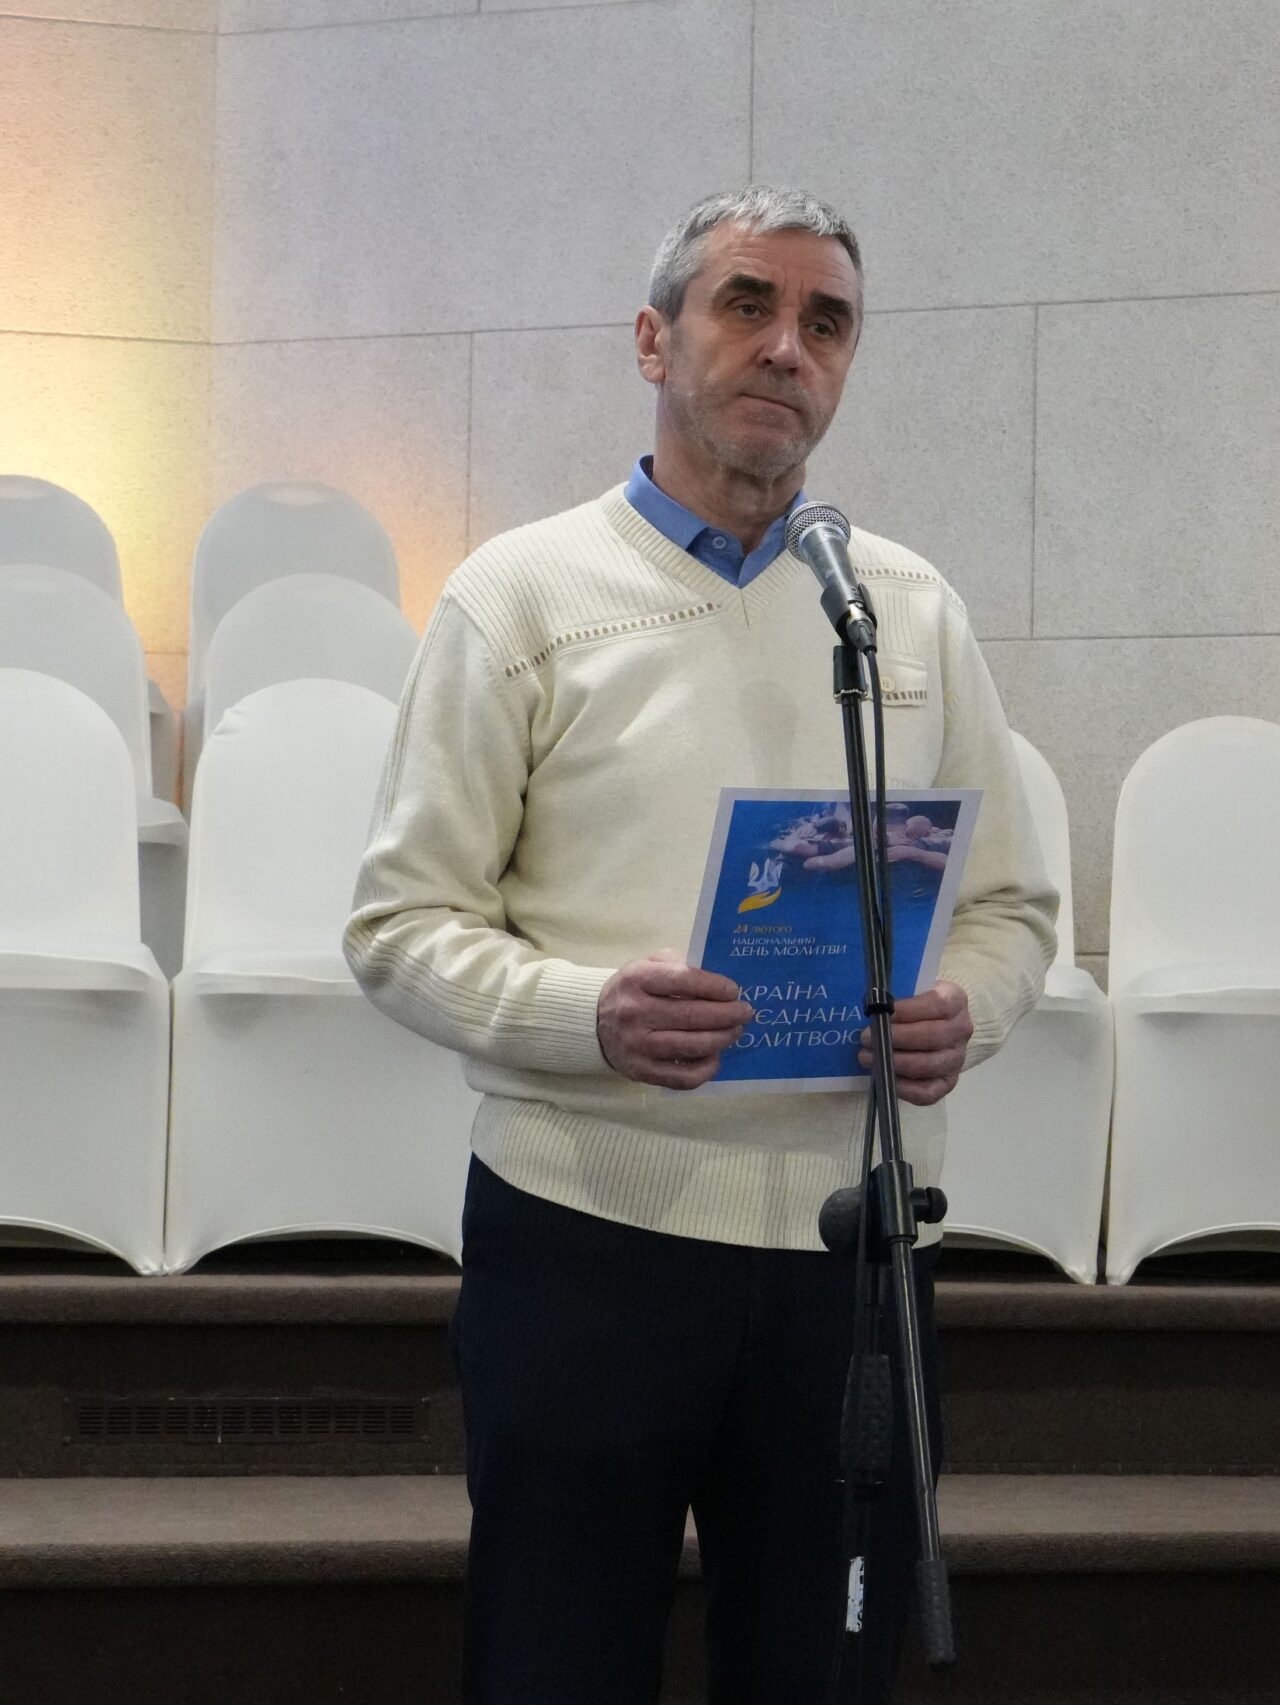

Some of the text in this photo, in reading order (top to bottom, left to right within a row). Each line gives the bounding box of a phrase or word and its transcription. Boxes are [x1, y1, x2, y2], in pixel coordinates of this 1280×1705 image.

[734, 924, 747, 933] 24
[733, 937, 815, 945] НАЦІОНАЛЬНИЙ
[730, 945, 847, 956] ДЕНЬ МОЛИТВИ
[737, 981, 828, 1002] КРАЇНА
[728, 1029, 863, 1048] ОЛИТВОЮ
